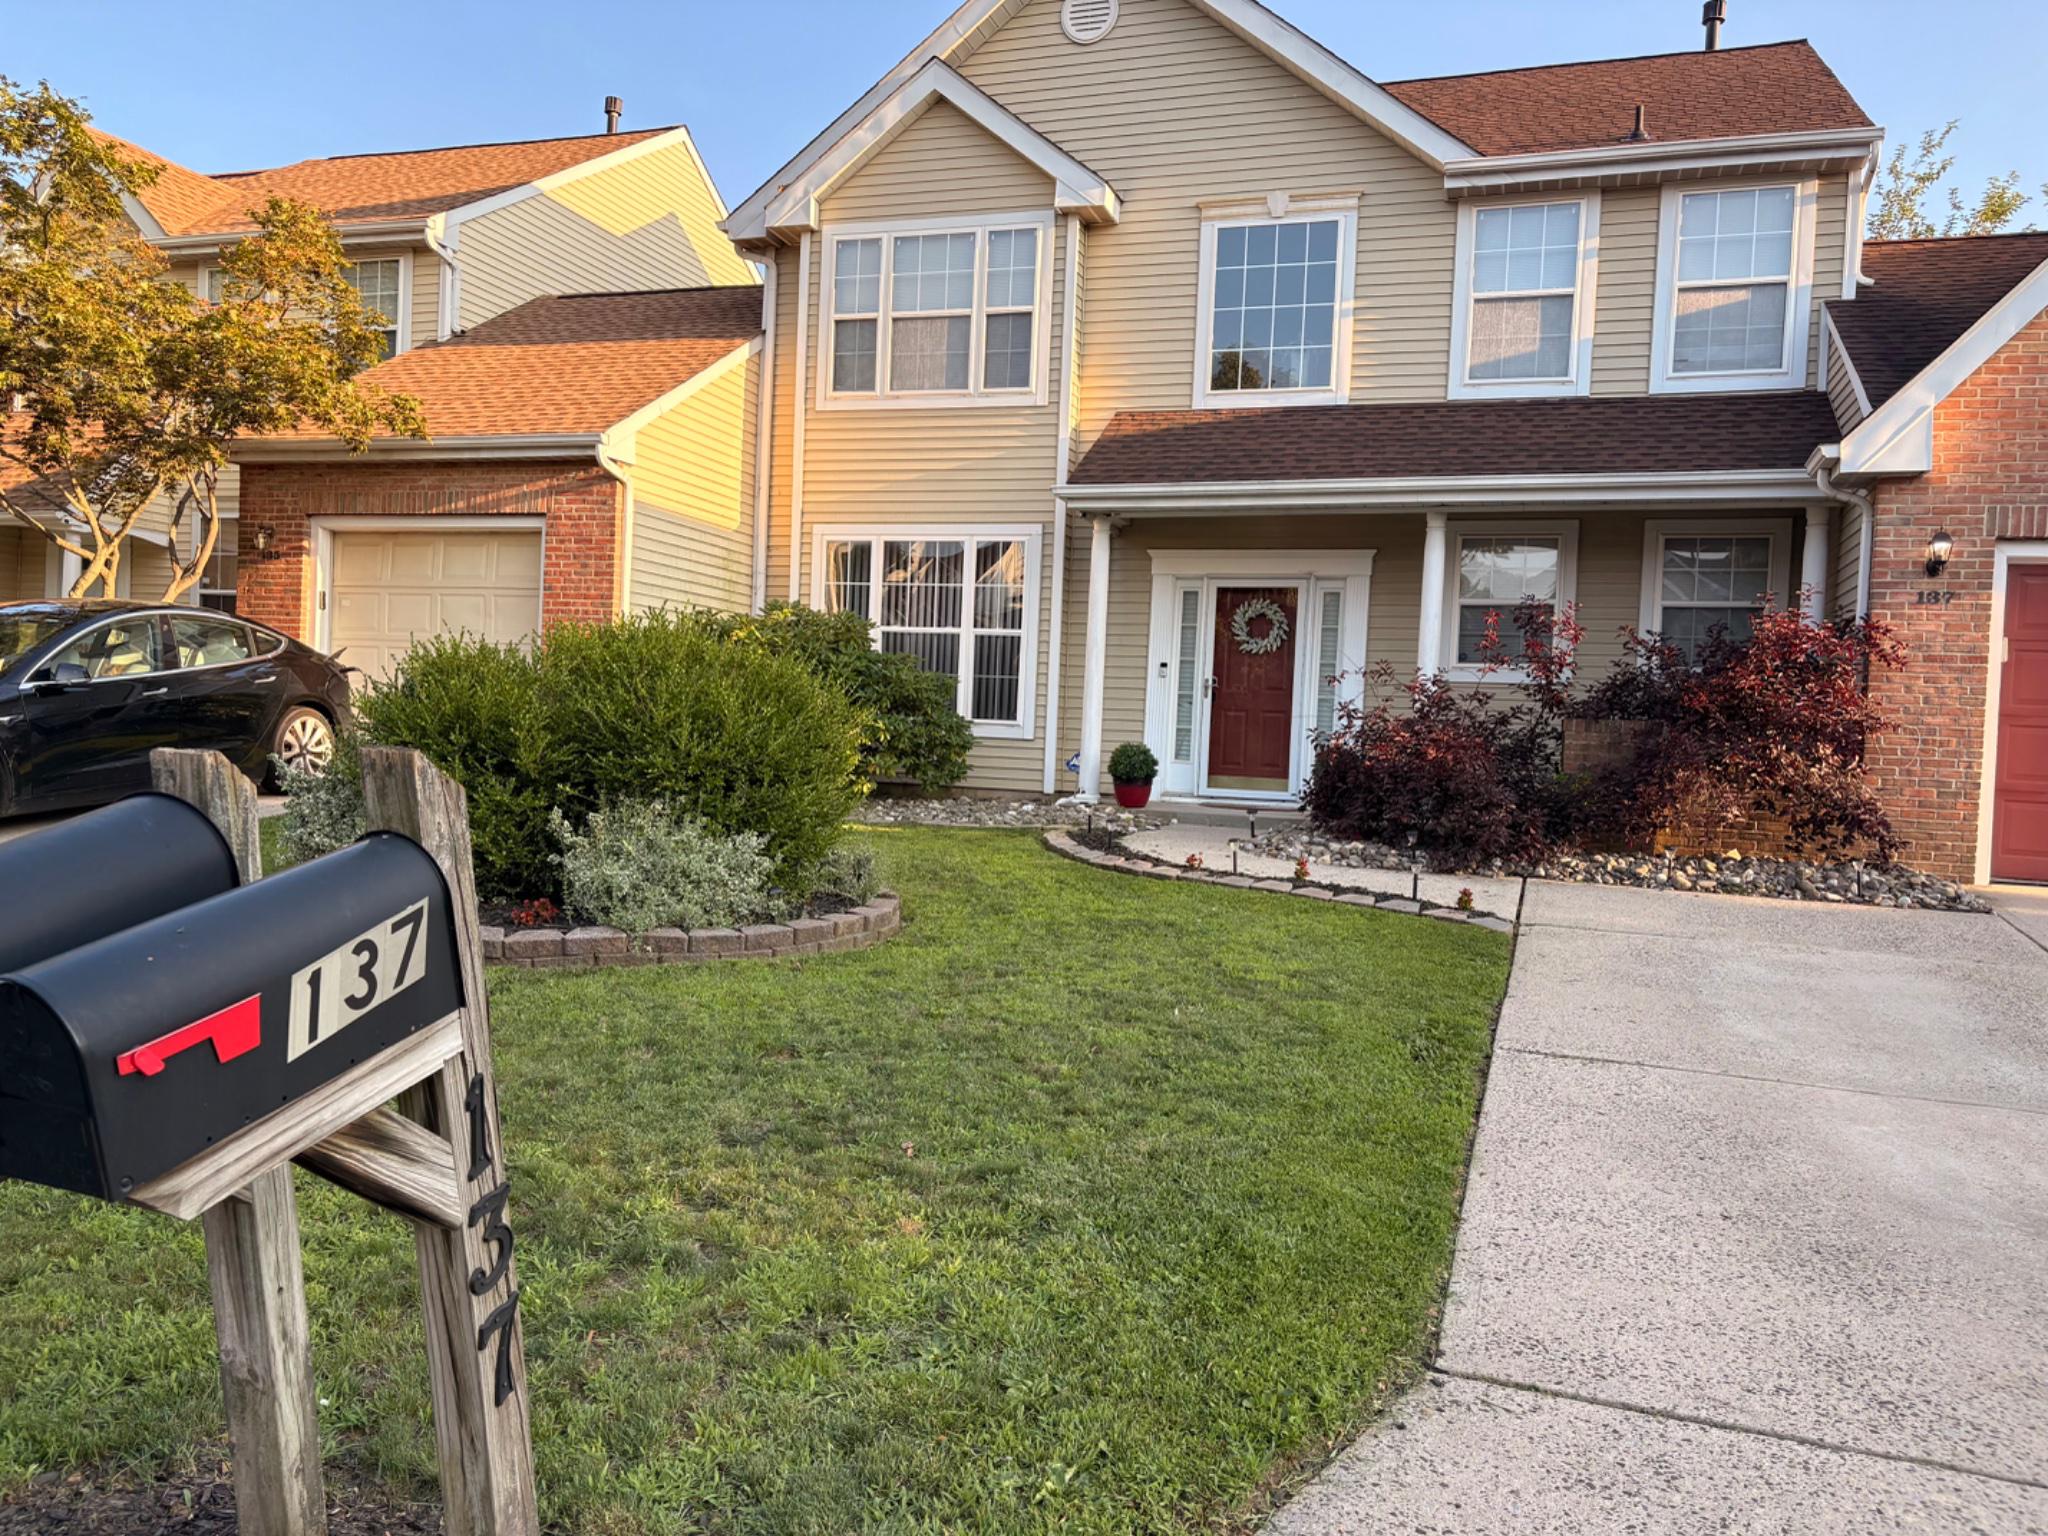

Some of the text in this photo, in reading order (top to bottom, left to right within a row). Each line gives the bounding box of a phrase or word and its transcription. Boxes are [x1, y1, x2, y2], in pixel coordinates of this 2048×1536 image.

[1916, 591, 1955, 604] 137
[307, 905, 424, 1045] 137
[465, 1072, 519, 1407] 137
